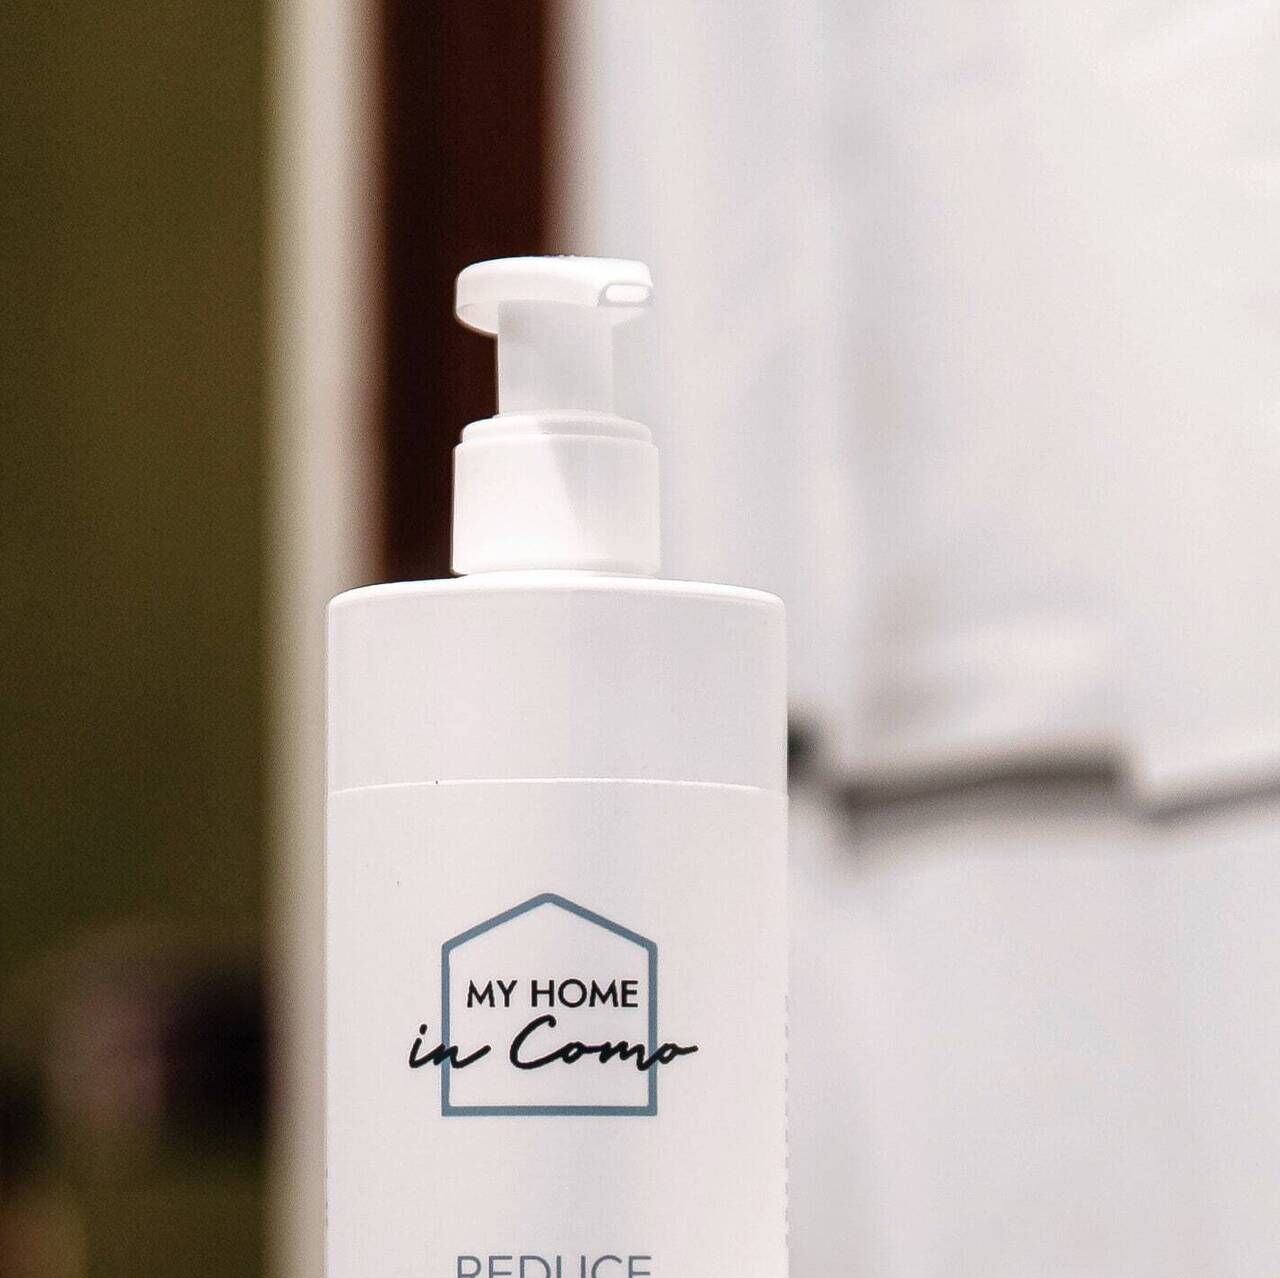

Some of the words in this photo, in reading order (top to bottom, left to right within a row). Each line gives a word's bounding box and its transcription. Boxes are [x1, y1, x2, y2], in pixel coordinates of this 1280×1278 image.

[467, 980, 517, 1007] MY
[532, 979, 637, 1007] HOME
[409, 1025, 491, 1068] in
[510, 1015, 698, 1070] Como
